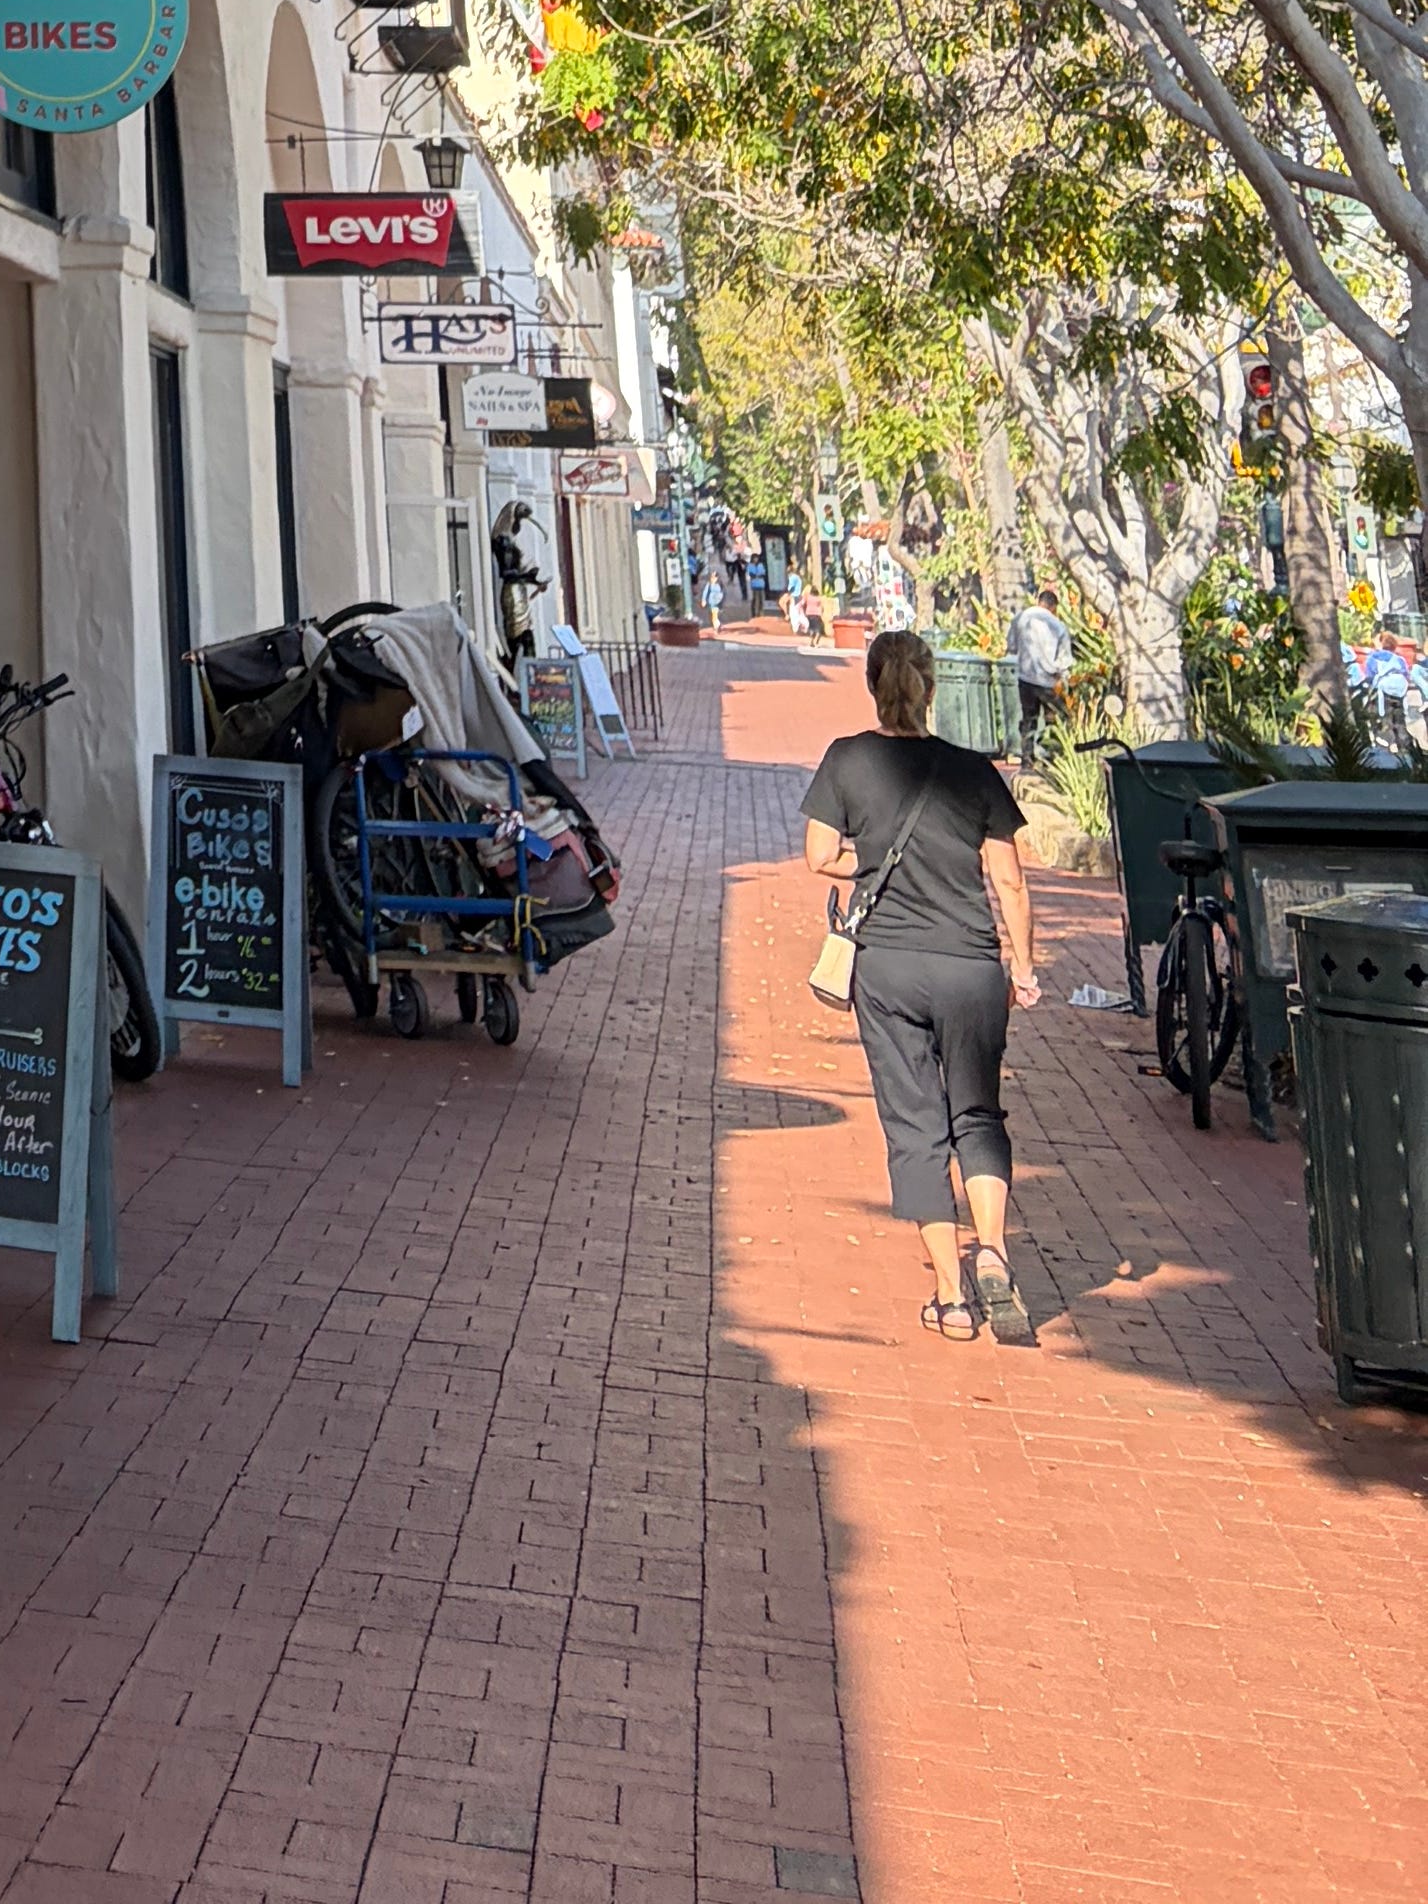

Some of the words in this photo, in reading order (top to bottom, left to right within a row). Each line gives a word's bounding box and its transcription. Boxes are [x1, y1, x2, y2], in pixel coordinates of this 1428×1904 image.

[4, 21, 118, 51] BIKES
[16, 96, 106, 123] SANTA
[448, 345, 506, 356] UNLIMITED
[517, 400, 541, 412] SPA
[174, 874, 265, 911] e-bike
[176, 918, 206, 955] 1
[207, 925, 234, 942] hour
[176, 958, 210, 999] 2
[204, 963, 240, 983] hours
[4, 1130, 54, 1155] After
